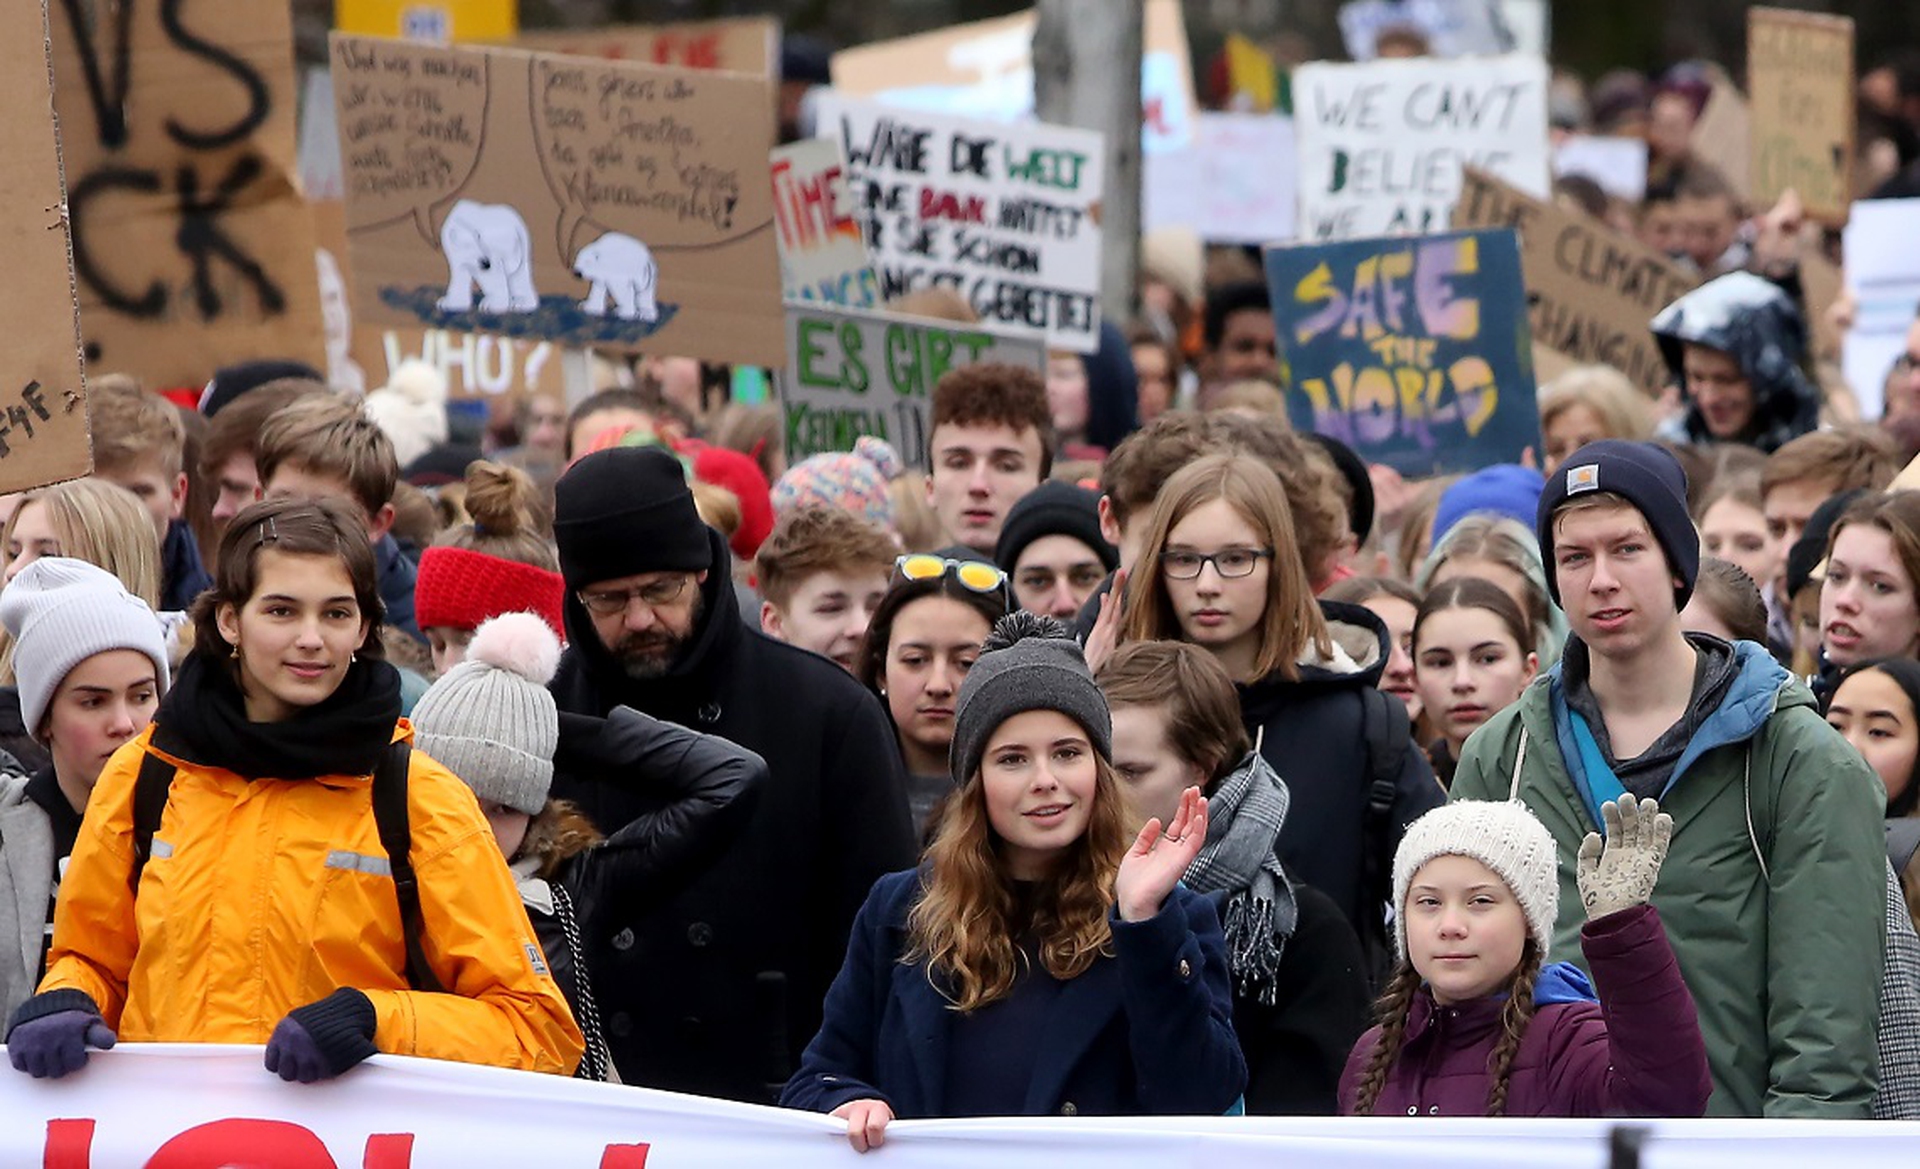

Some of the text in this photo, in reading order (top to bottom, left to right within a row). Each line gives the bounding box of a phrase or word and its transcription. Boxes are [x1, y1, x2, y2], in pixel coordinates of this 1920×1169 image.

[1312, 81, 1387, 135] WE
[1003, 143, 1088, 191] WELT
[1294, 236, 1481, 346] SAFE
[798, 318, 870, 393] ES
[1370, 334, 1438, 368] THE
[1302, 355, 1498, 448] WORLD
